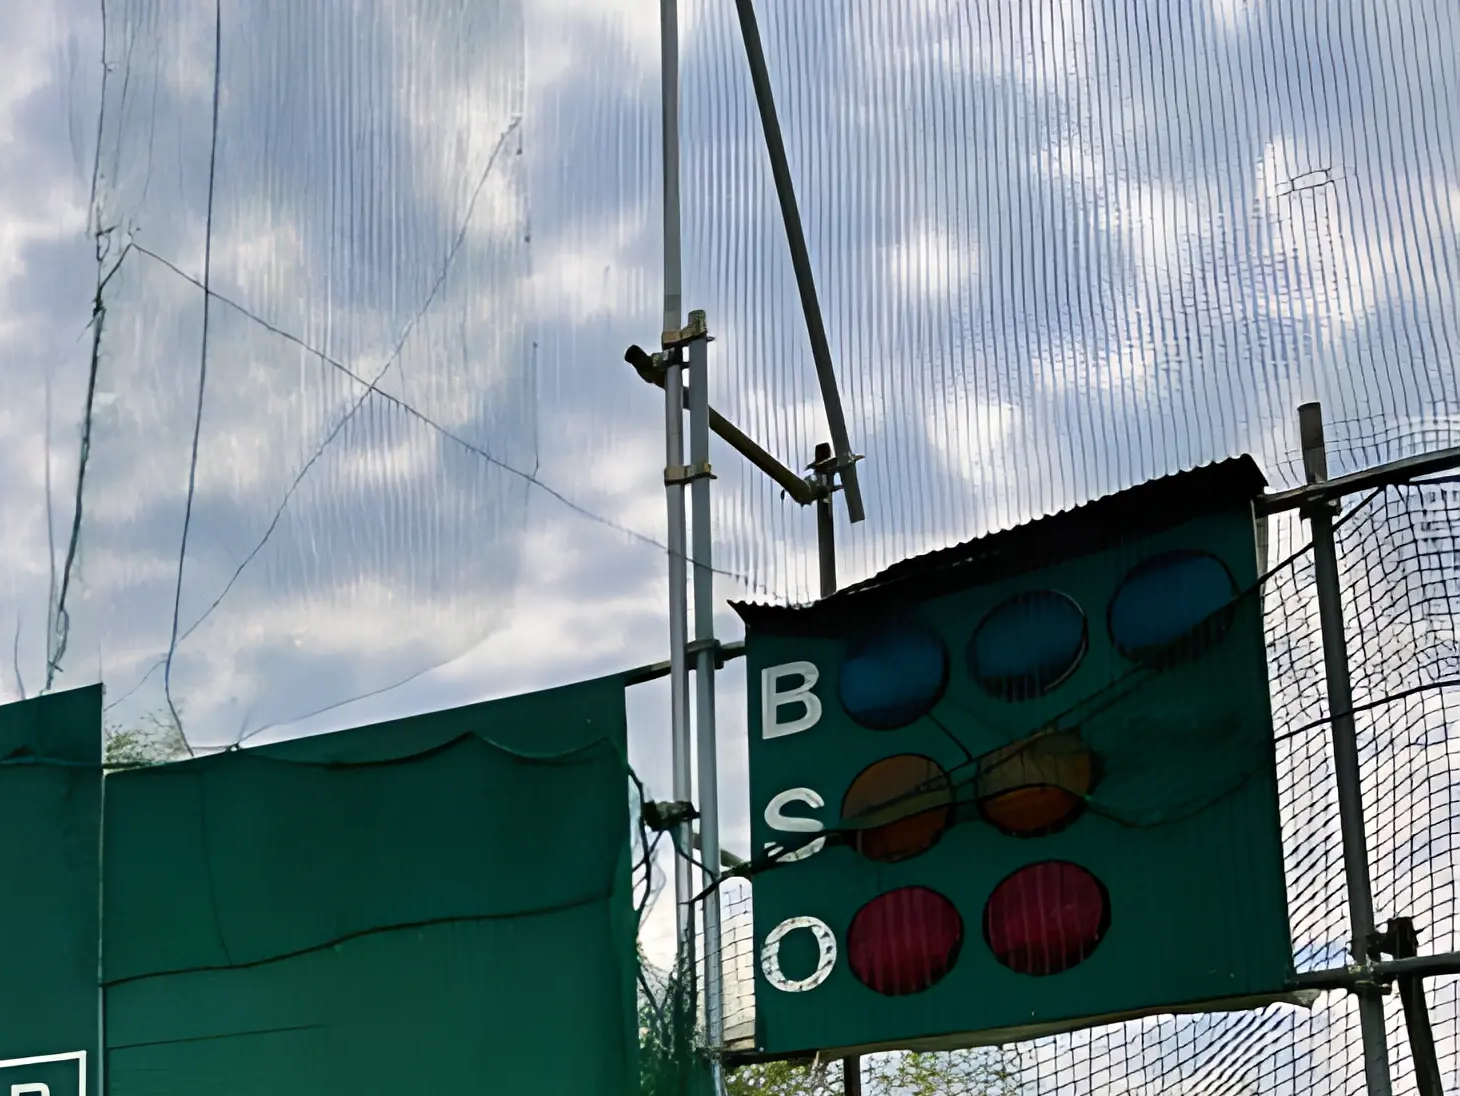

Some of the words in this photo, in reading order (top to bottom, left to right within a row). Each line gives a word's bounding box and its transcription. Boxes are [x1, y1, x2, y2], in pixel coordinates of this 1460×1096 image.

[761, 661, 822, 740] B
[764, 787, 825, 862] S
[760, 916, 837, 992] O
